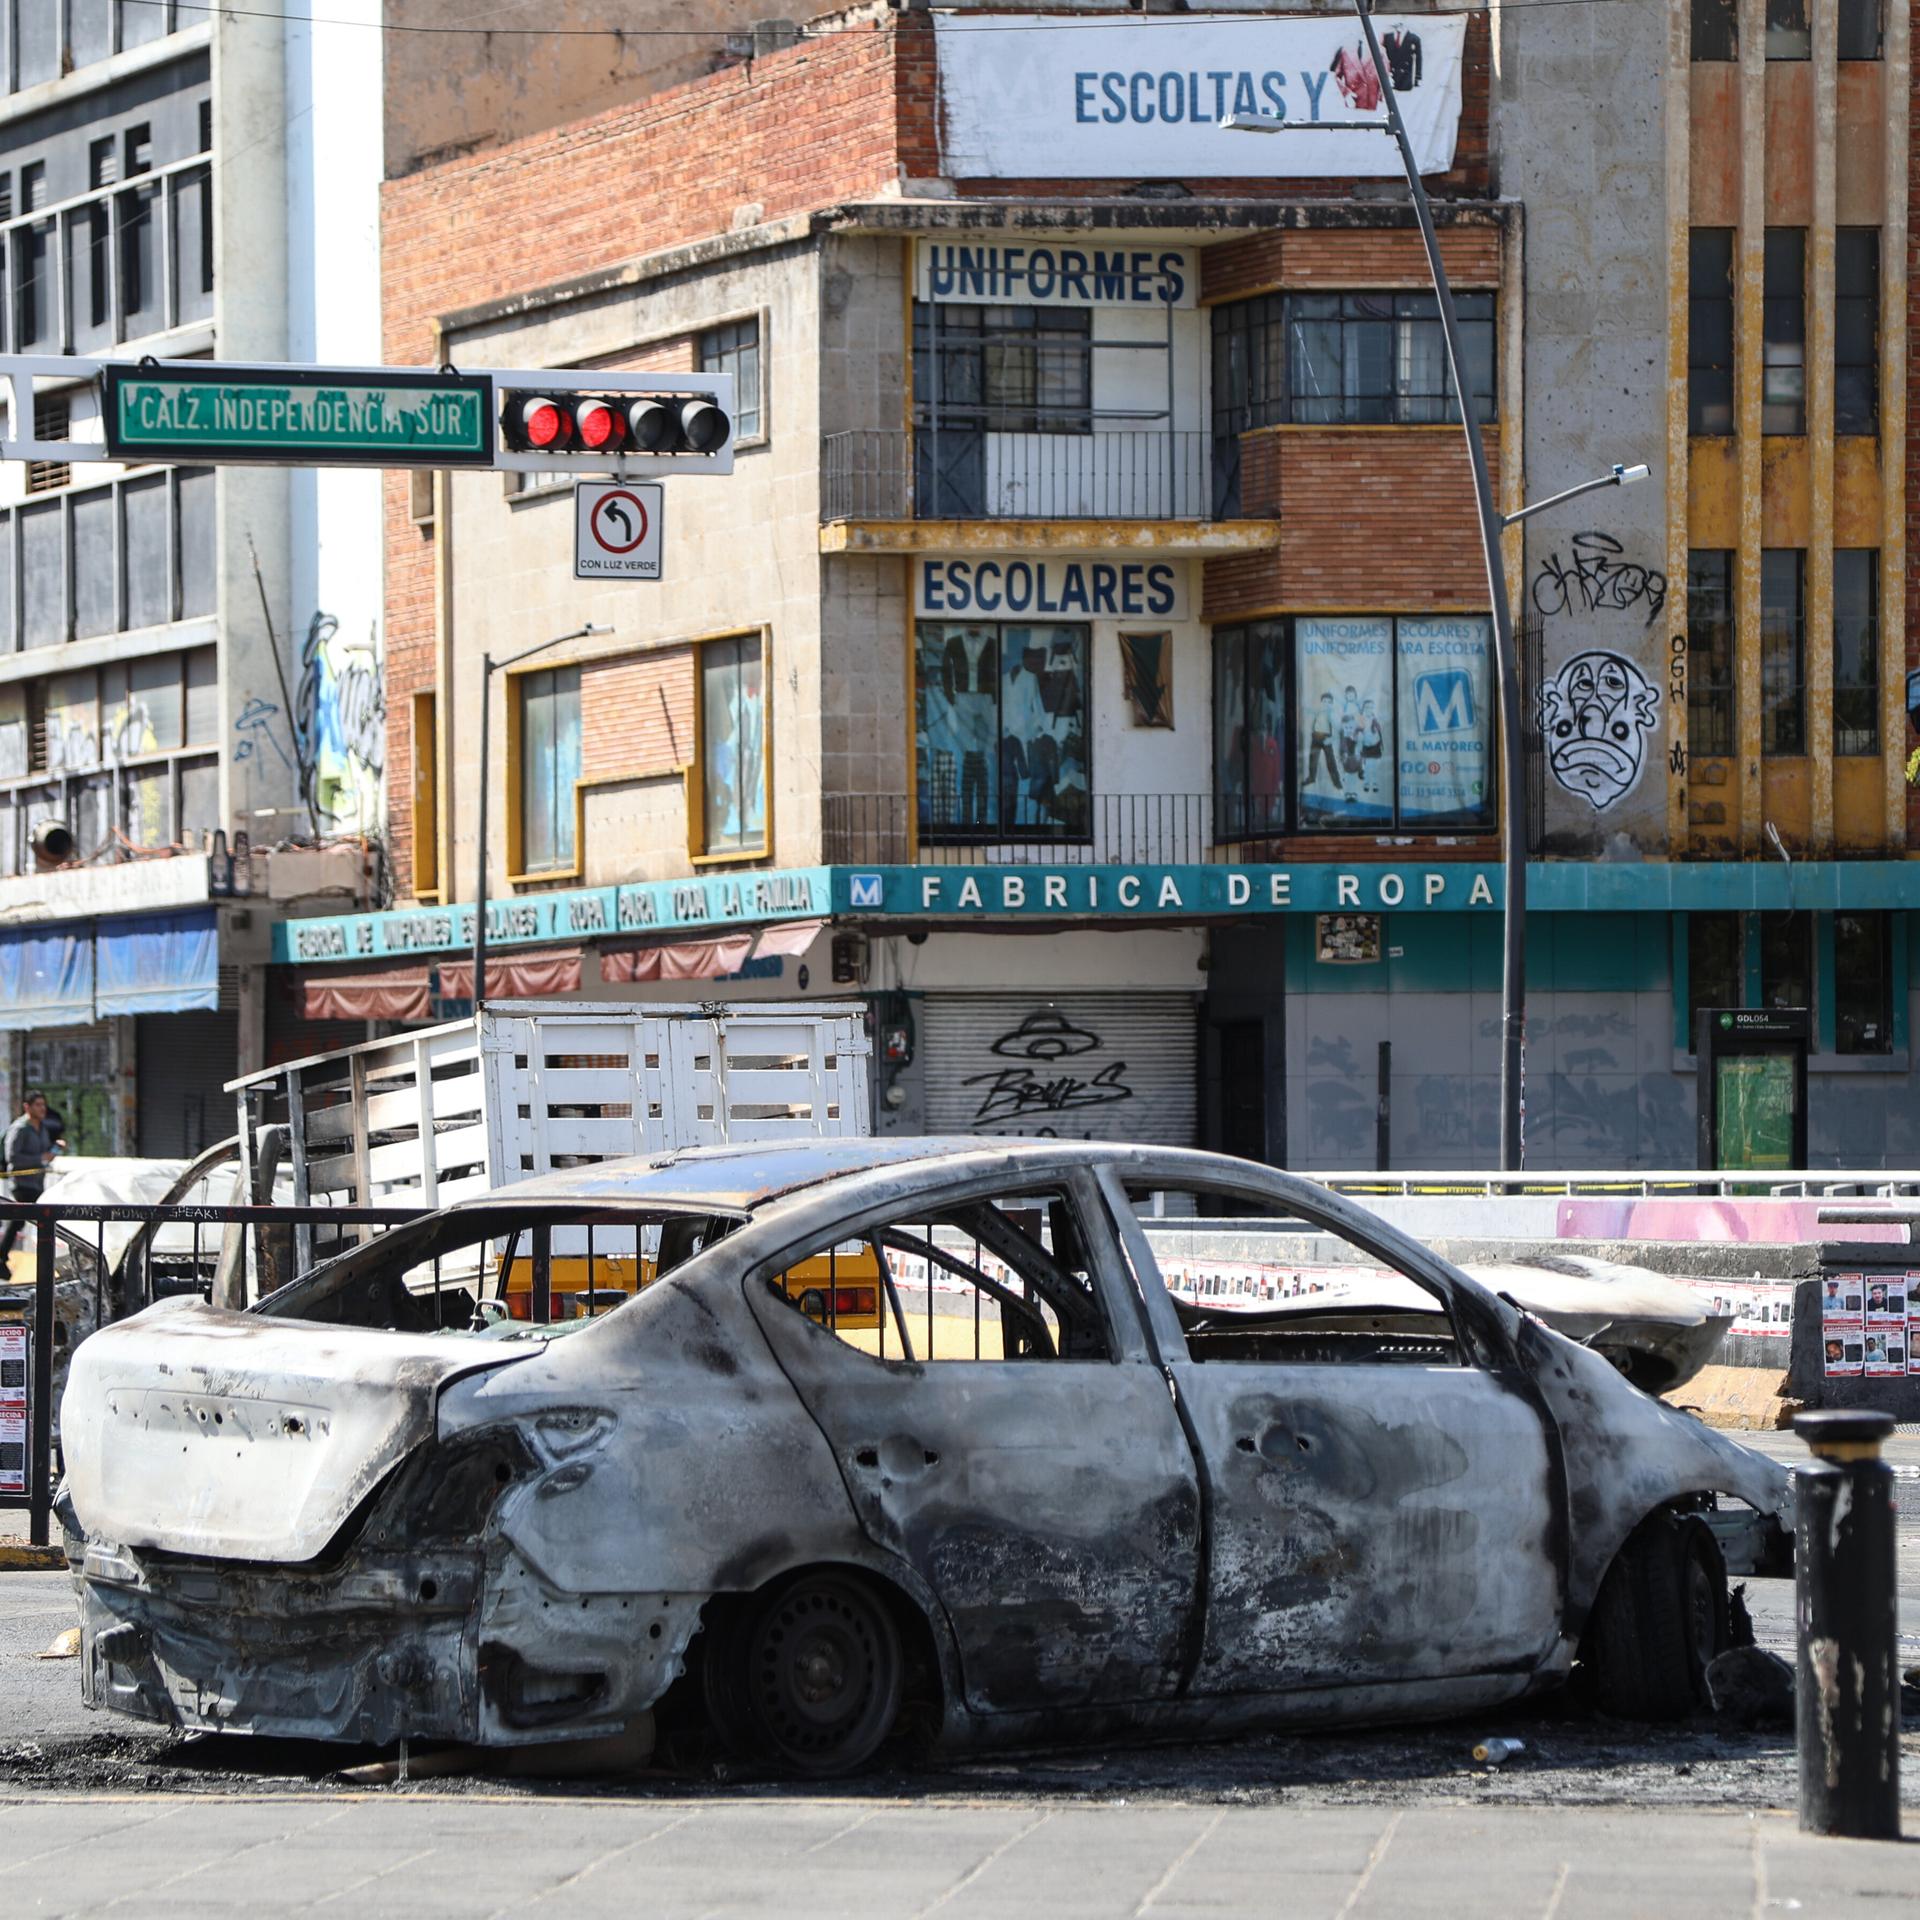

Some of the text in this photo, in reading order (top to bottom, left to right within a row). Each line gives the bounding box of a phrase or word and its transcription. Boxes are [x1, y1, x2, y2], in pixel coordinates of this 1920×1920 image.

[1075, 71, 1328, 123] ESCOLTAS Y
[930, 245, 1185, 303] UNIFORMES
[141, 396, 208, 429] CALZ.
[214, 397, 404, 434] INDEPENDENCIA
[580, 560, 657, 570] CON LUZ VERDE
[924, 560, 1176, 614] ESCOLARES
[1304, 623, 1388, 638] UNIFORMES
[1399, 623, 1470, 638] SCOLARES
[1304, 641, 1386, 655] UNIFORMES
[1398, 642, 1423, 655] ARA
[1406, 740, 1484, 752] EL MAYOREO
[922, 873, 1493, 908] FABRICA DE ROPA
[462, 904, 537, 944] ESOLARES
[618, 891, 657, 926] PARA
[724, 882, 744, 917] LA
[755, 875, 814, 914] FAMILIA
[1737, 1014, 1769, 1023] GDL054
